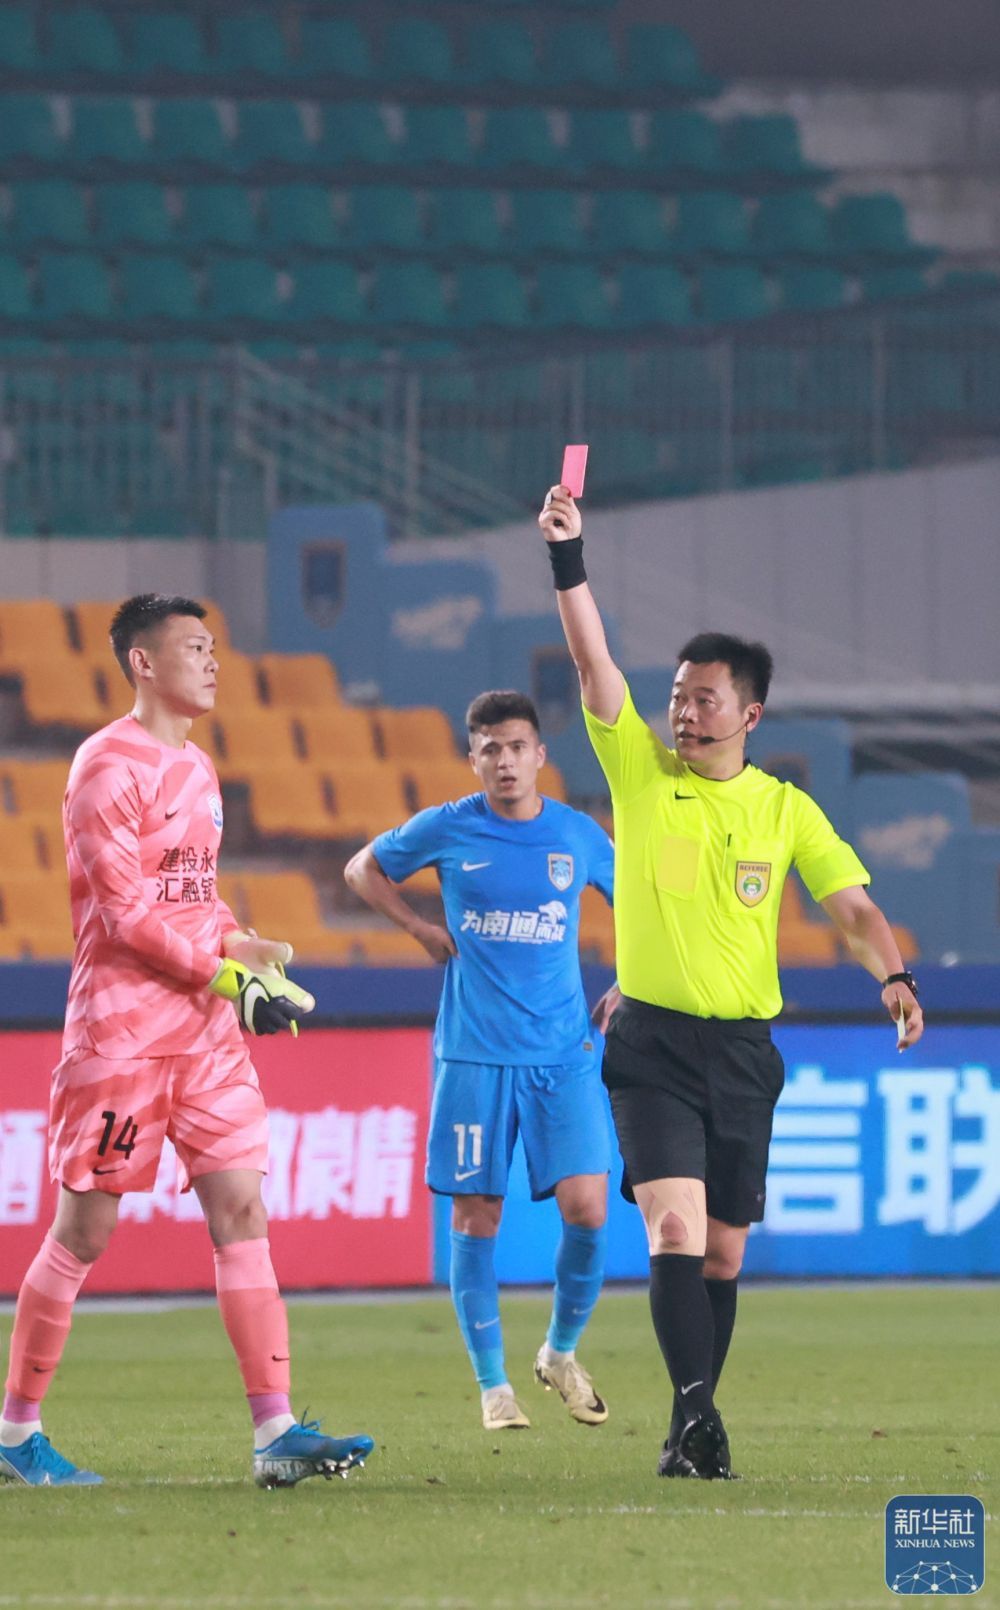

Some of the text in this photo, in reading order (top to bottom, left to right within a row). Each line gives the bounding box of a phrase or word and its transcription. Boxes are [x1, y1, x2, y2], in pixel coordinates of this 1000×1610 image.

[156, 846, 214, 873] 建投永
[97, 1110, 138, 1160] 14
[453, 1123, 482, 1167] 11
